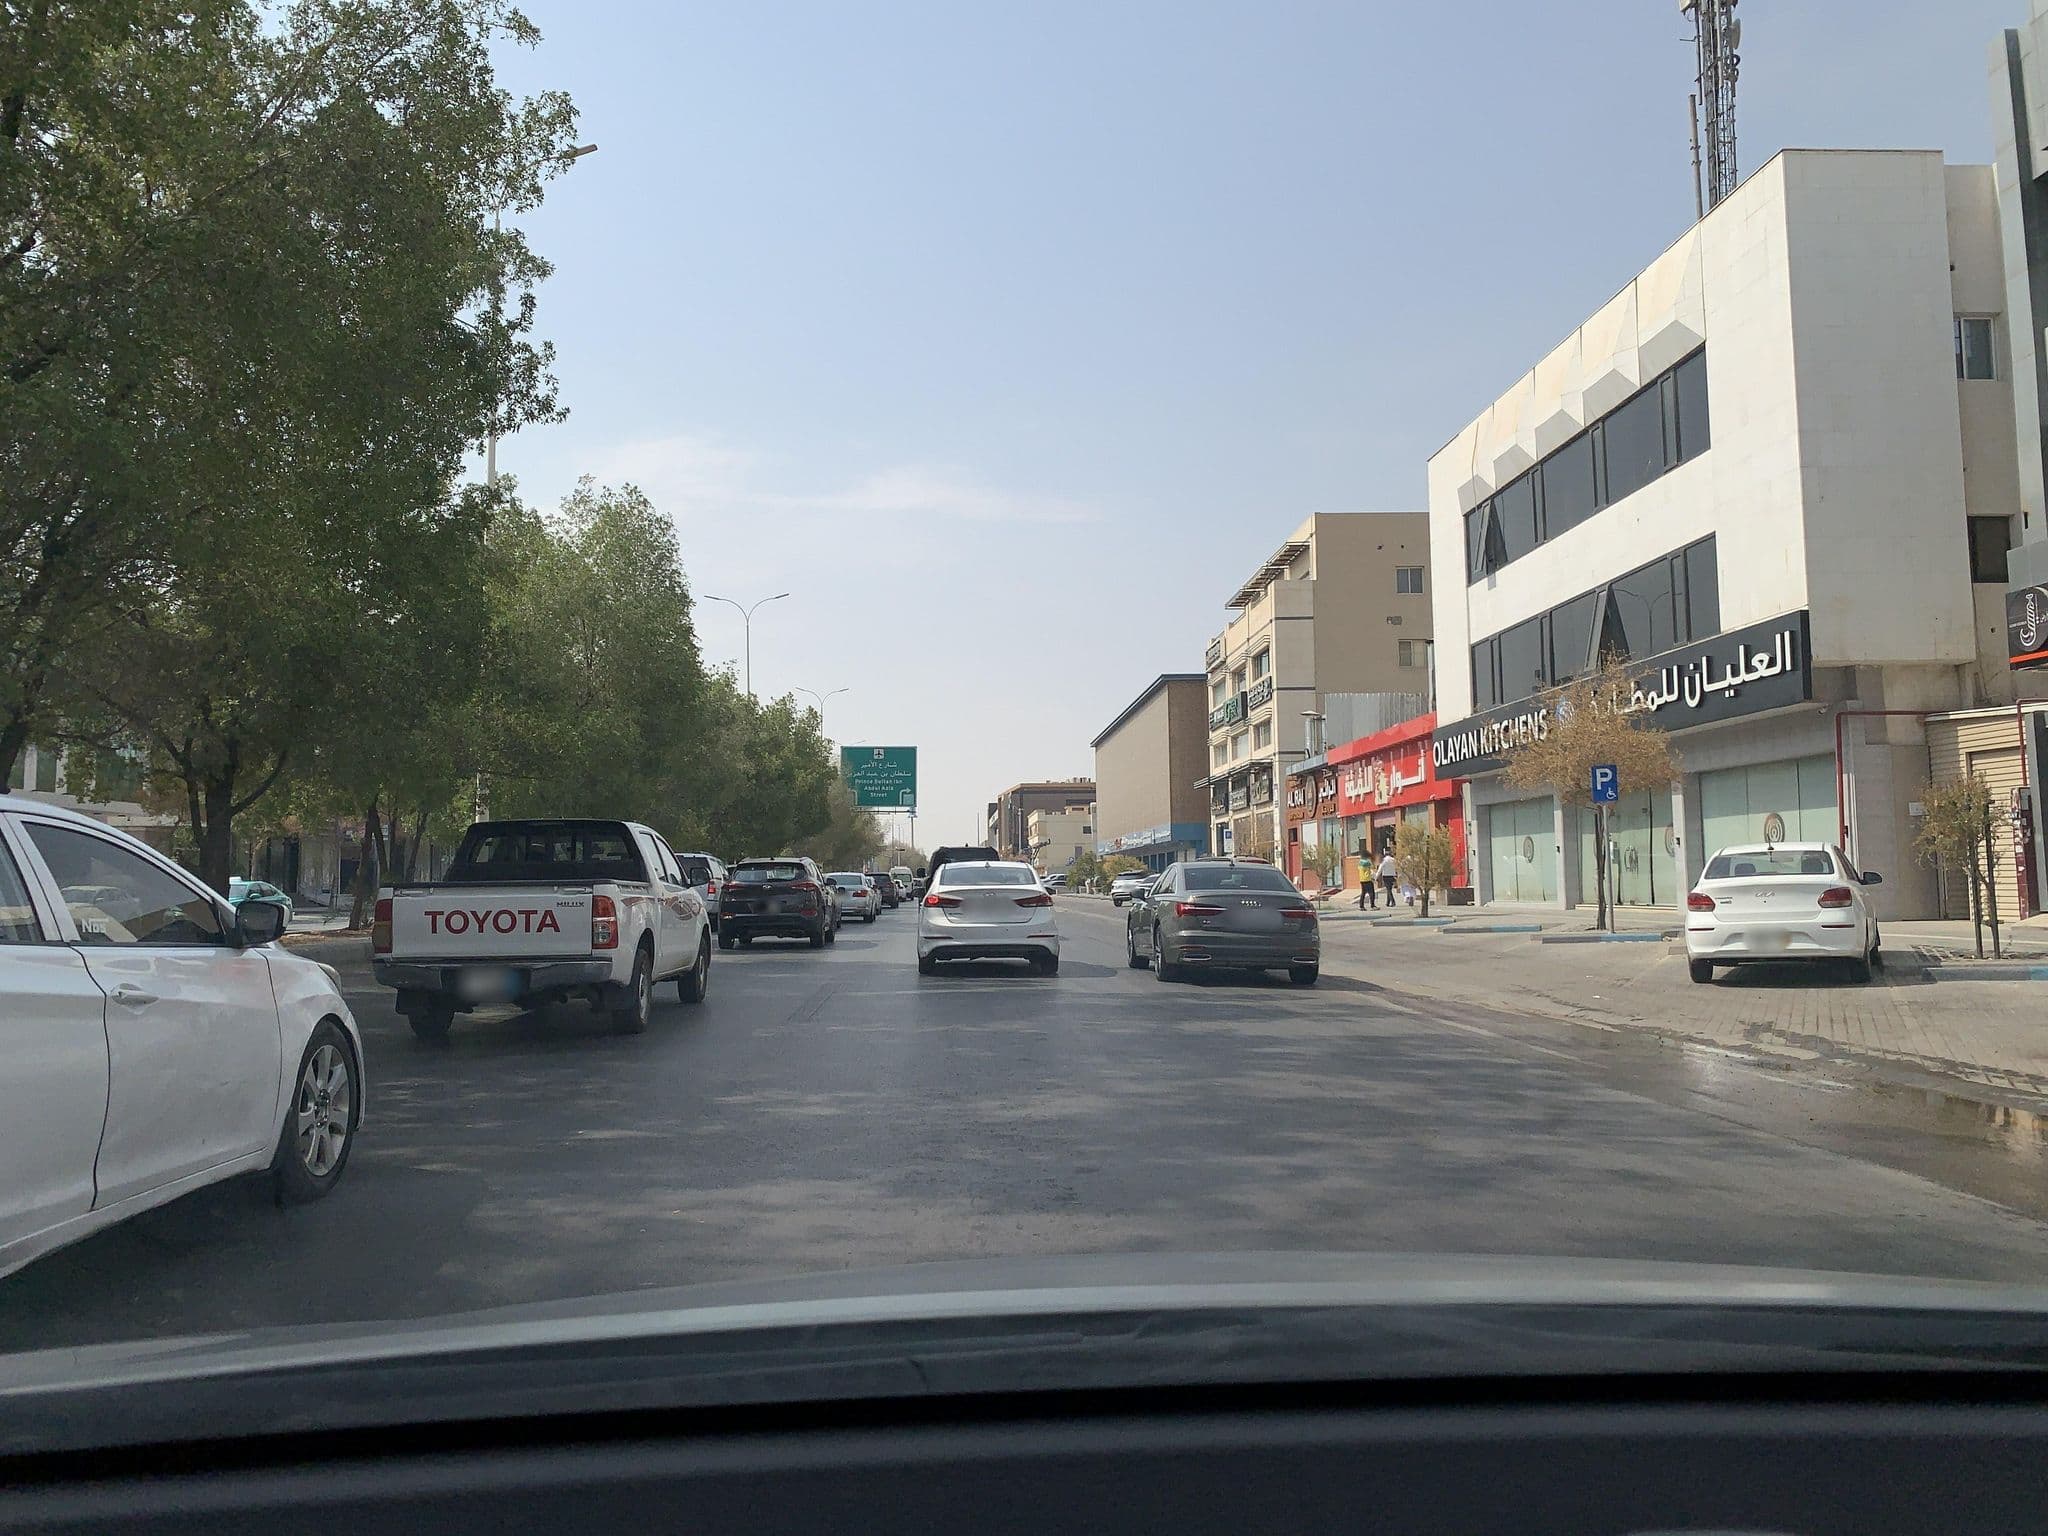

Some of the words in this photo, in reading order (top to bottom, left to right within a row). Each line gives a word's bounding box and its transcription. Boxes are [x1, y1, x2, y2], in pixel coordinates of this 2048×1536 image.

[1683, 630, 1793, 708] العليان
[1432, 729, 1478, 768] OLAYAN
[1480, 708, 1548, 754] KITCHENS
[878, 761, 898, 769] شارع
[889, 770, 912, 778] سلطان
[1595, 768, 1613, 790] P
[424, 909, 561, 934] TOYOTA
